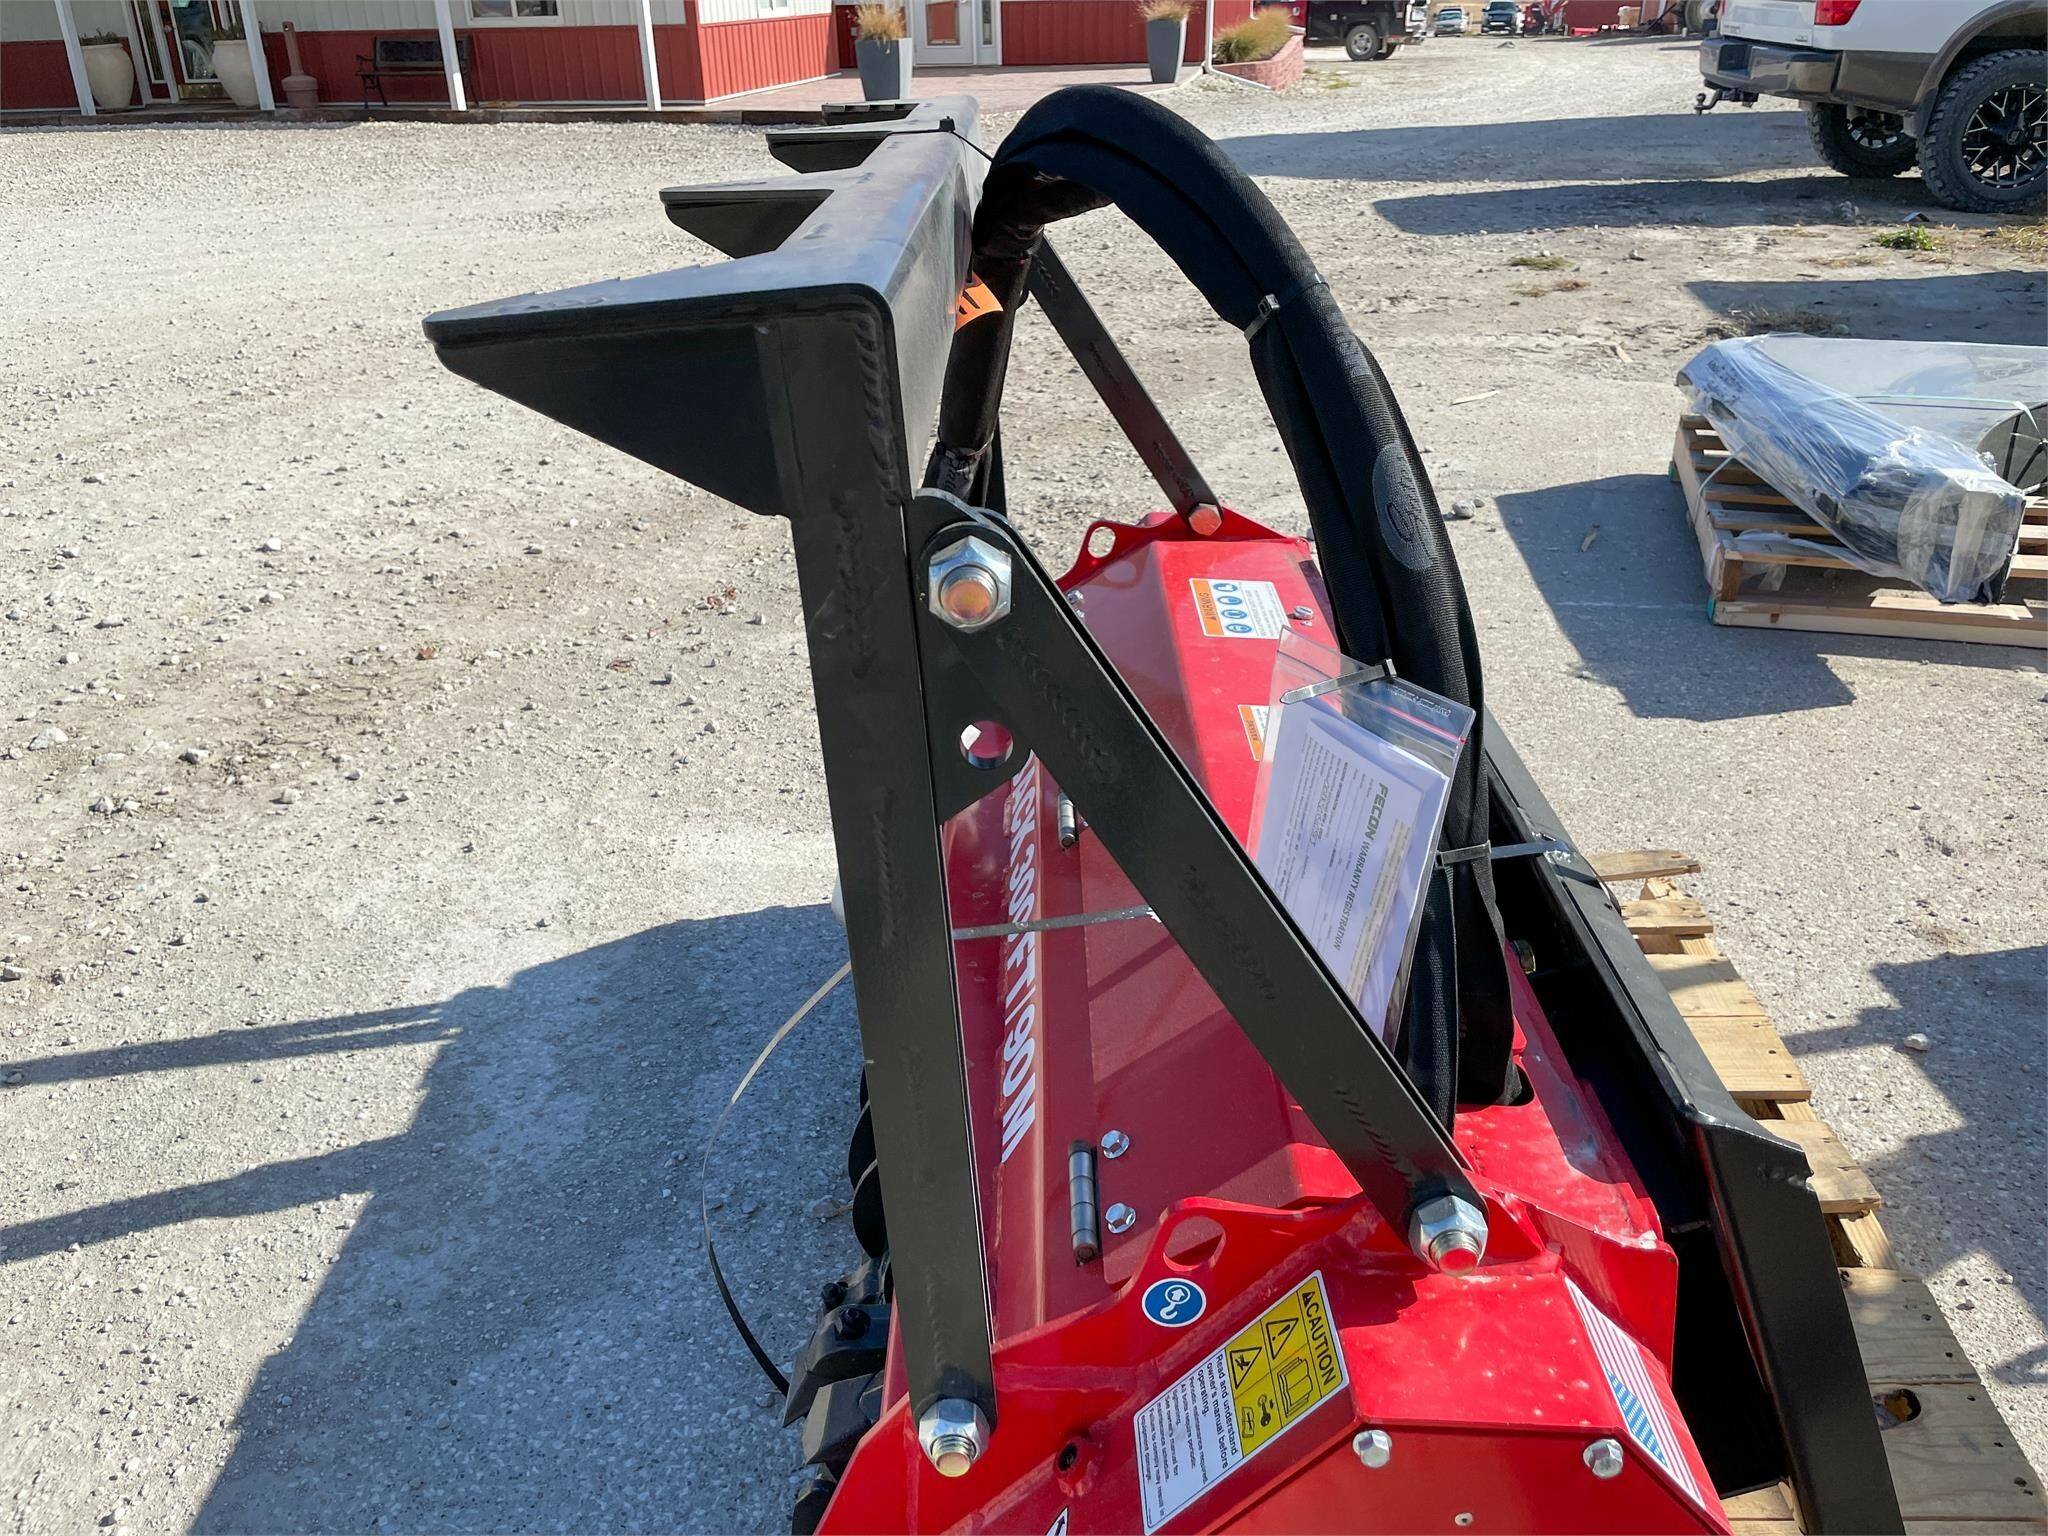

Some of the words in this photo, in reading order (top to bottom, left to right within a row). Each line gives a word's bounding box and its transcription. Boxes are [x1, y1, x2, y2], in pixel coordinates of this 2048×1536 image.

[1011, 752, 1036, 866] ACK
[1365, 783, 1389, 840] FECON
[1349, 841, 1370, 891] WARRANTY
[1333, 889, 1356, 951] REGISTRATION
[1216, 1353, 1226, 1379] Read
[1306, 1302, 1336, 1386] CAUTION
[1207, 1362, 1217, 1398] owner's
[1212, 1399, 1224, 1435] manual
[1218, 1435, 1228, 1469] before
[1220, 1380, 1229, 1399] and
[1223, 1399, 1238, 1456] understand
